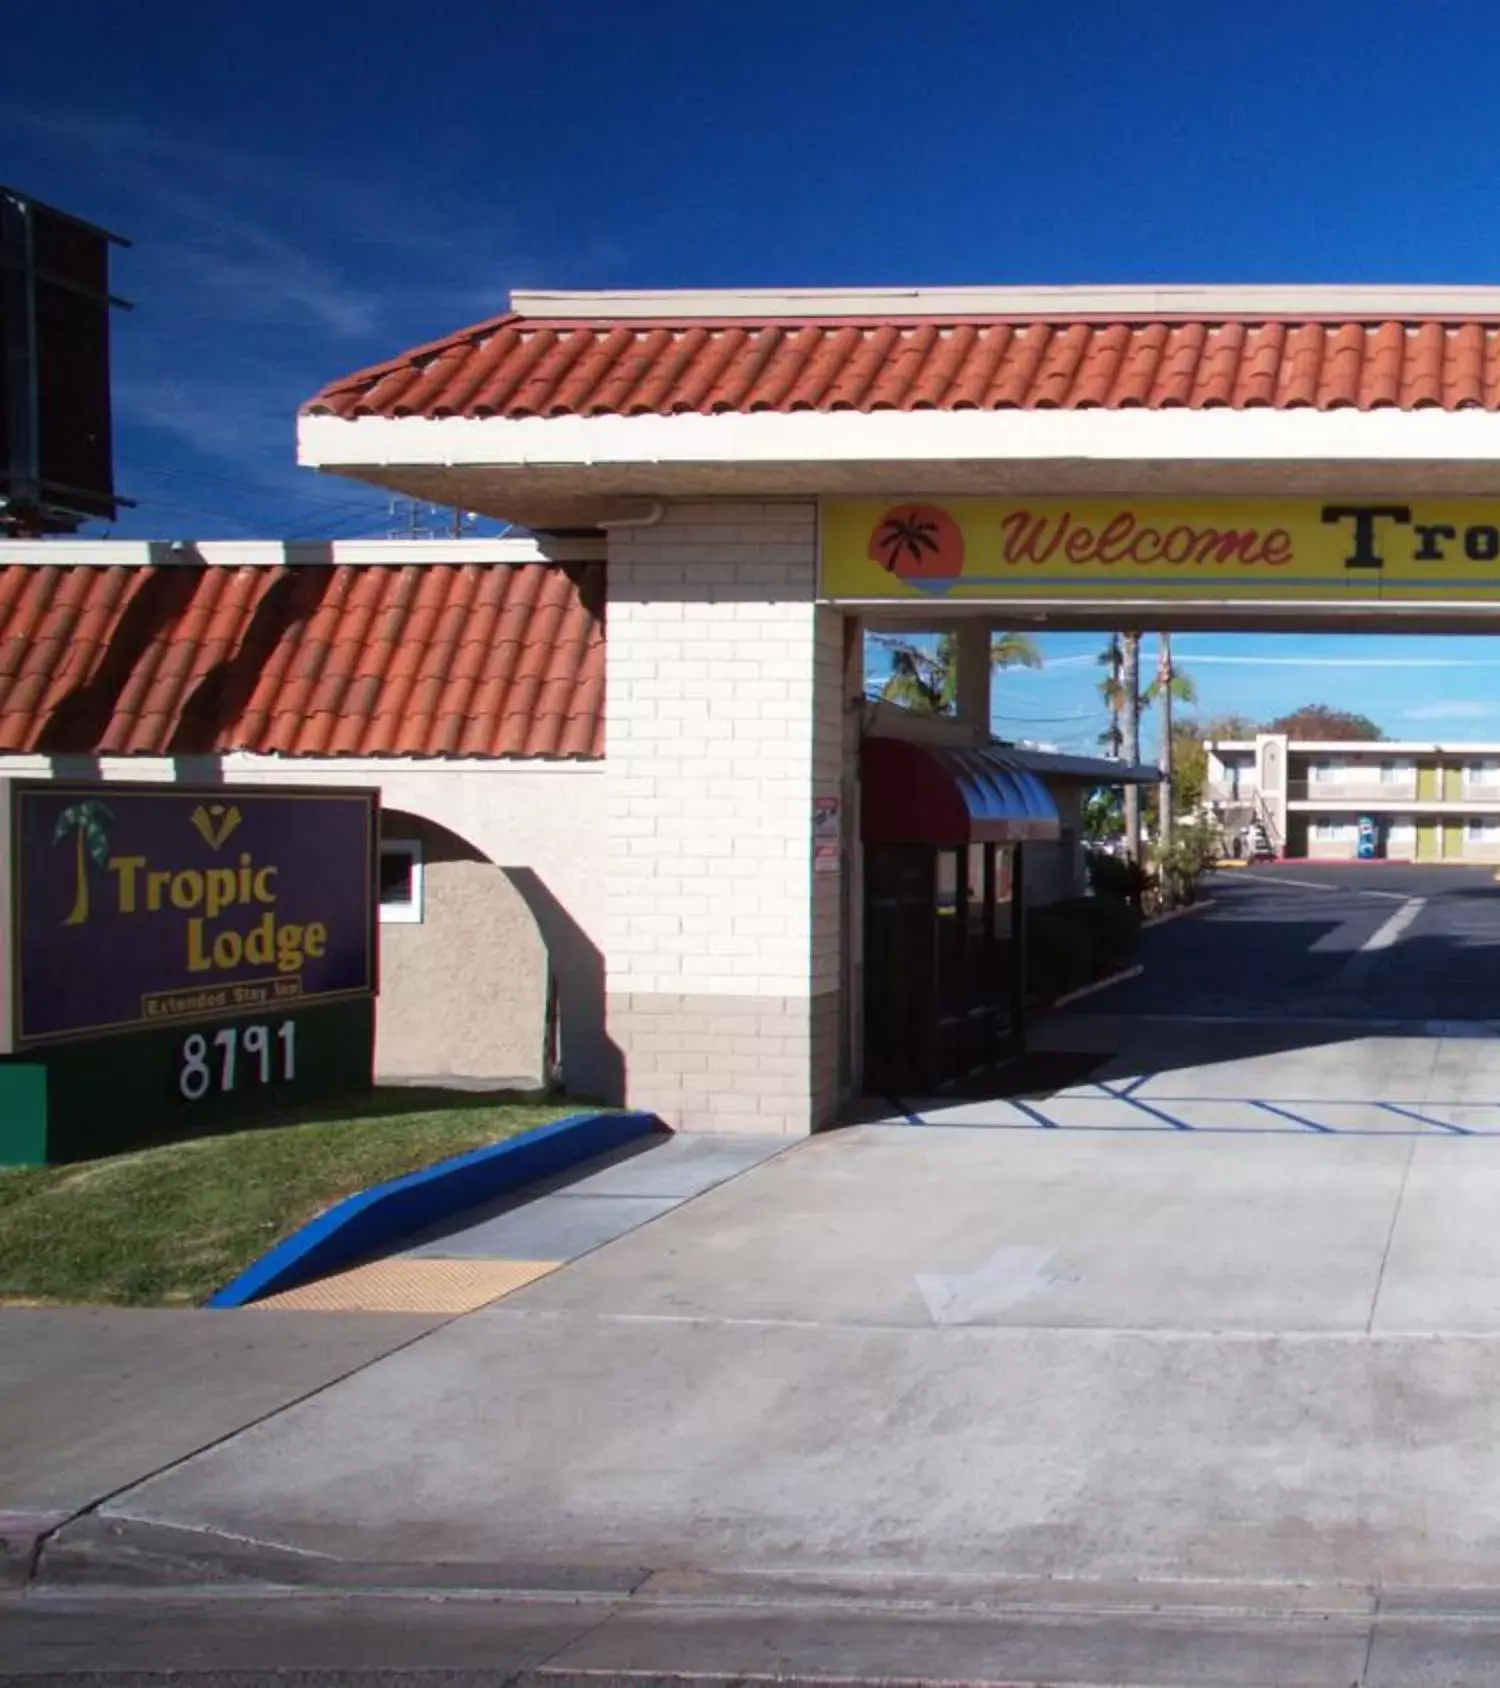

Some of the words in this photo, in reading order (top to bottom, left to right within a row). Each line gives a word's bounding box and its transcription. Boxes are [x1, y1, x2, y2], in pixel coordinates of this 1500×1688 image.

[1001, 511, 1293, 565] Welcome
[109, 853, 278, 918] Tropic
[187, 912, 327, 971] Lodge
[180, 1020, 296, 1100] 8791
